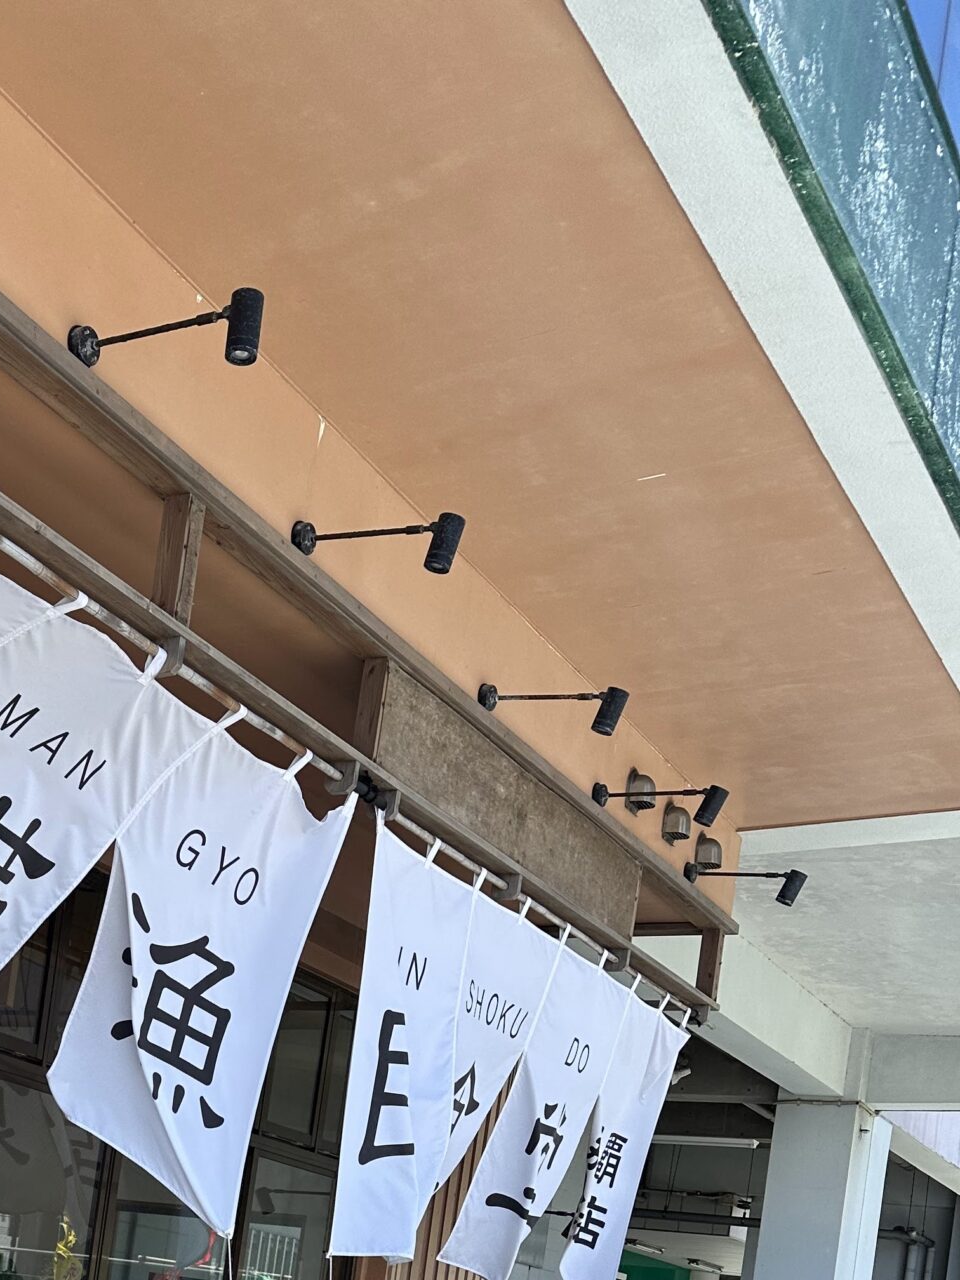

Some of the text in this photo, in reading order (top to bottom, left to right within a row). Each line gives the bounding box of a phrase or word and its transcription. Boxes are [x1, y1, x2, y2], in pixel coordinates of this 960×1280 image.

[176, 829, 260, 906] GYO
[464, 978, 529, 1039] SHOKU
[564, 1036, 590, 1074] DO
